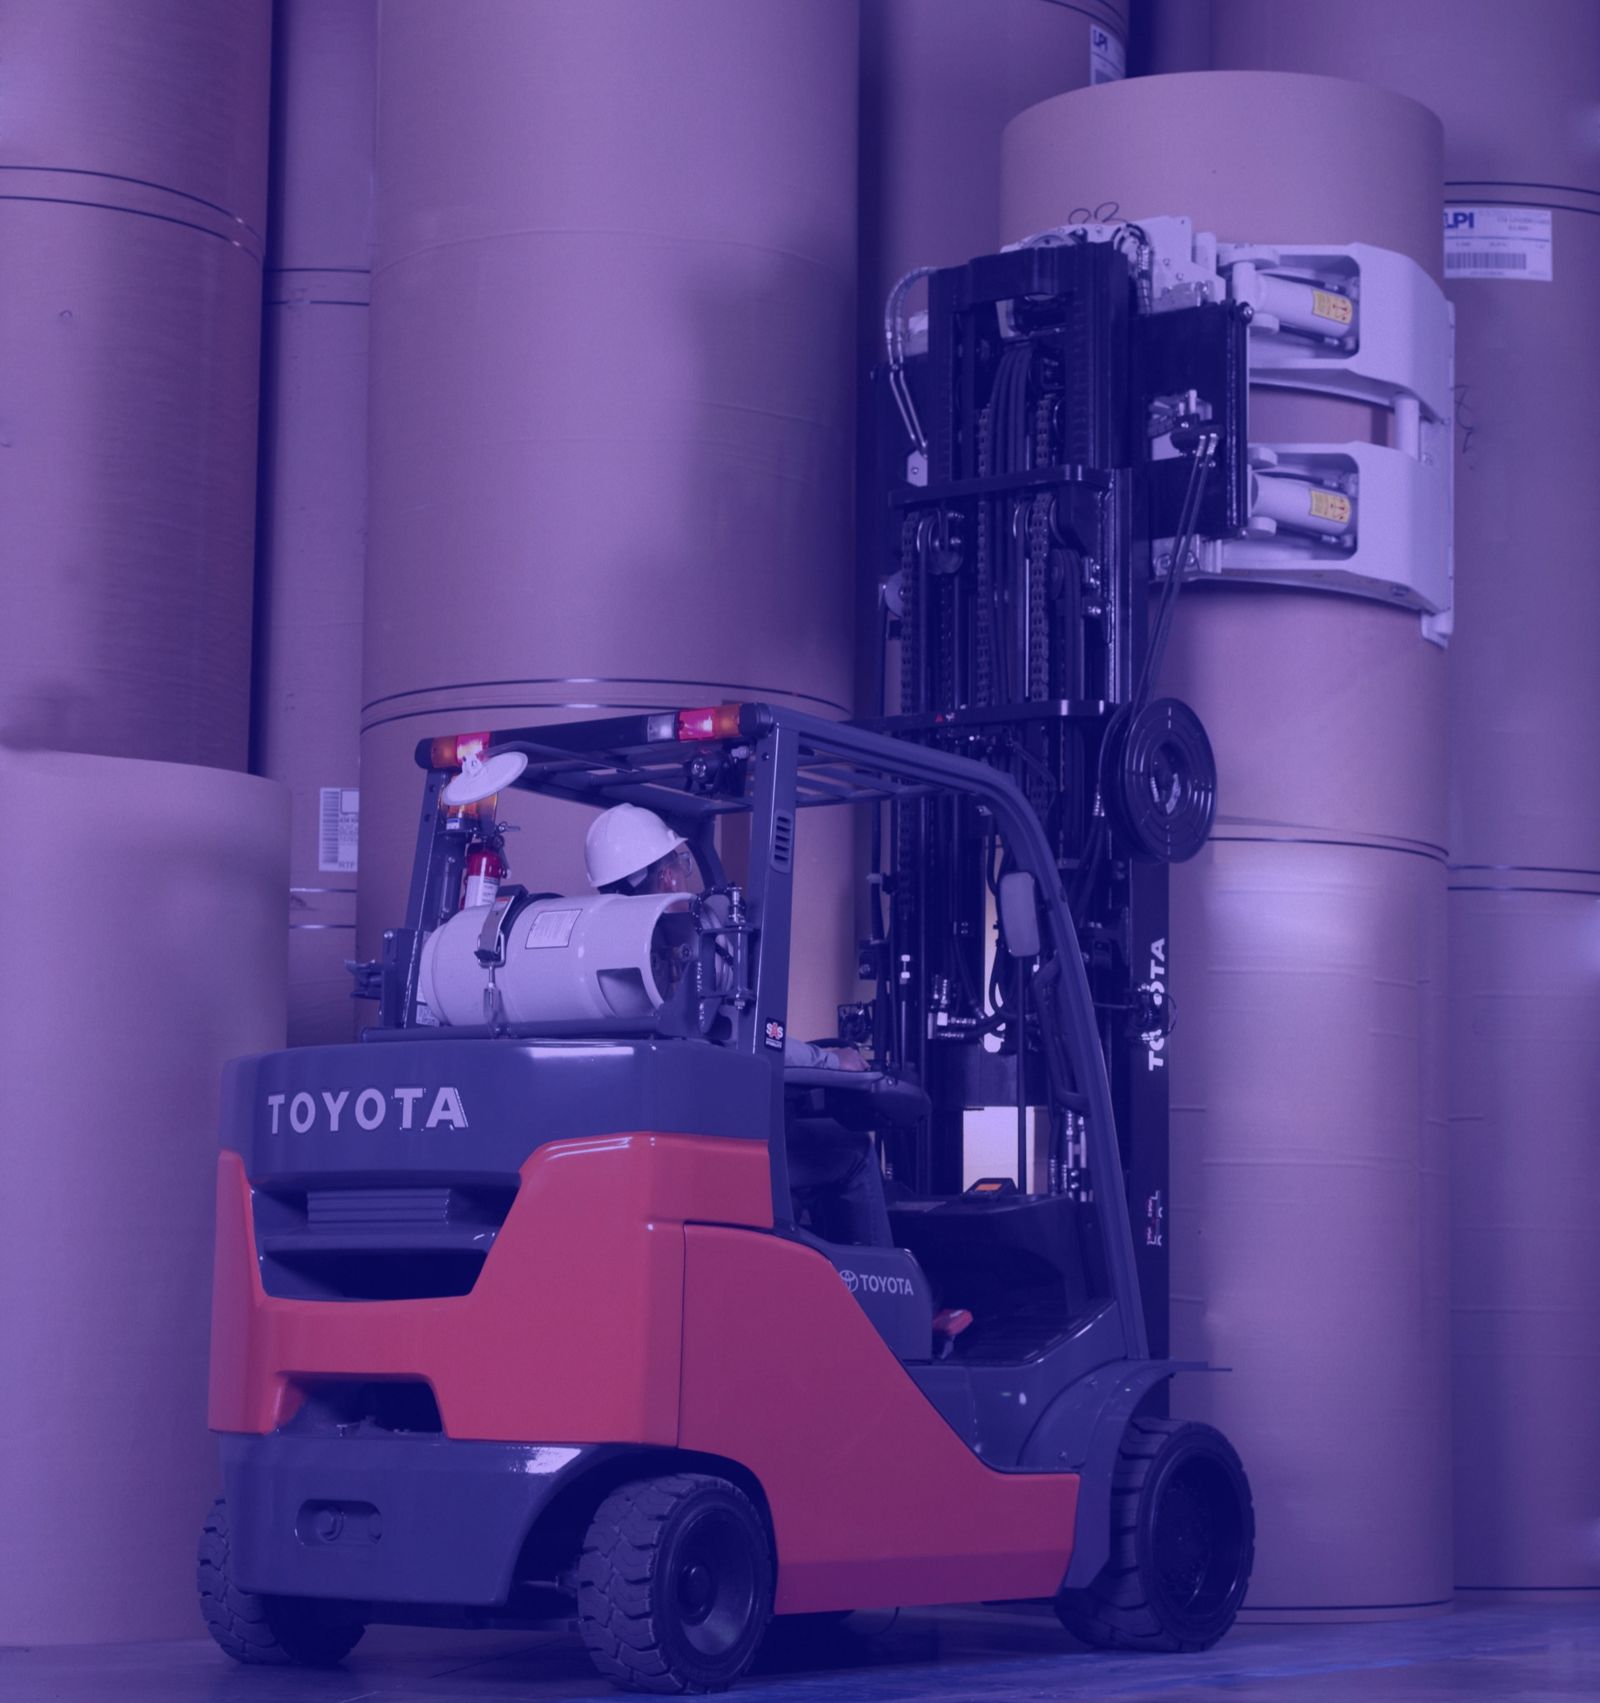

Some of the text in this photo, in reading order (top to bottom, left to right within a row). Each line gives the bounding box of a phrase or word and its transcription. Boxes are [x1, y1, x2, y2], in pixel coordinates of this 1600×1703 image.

[1148, 937, 1165, 1072] TOOTA
[765, 1022, 784, 1040] SAS
[267, 1086, 469, 1135] TOYOTA
[859, 1273, 915, 1296] TOYOTA
